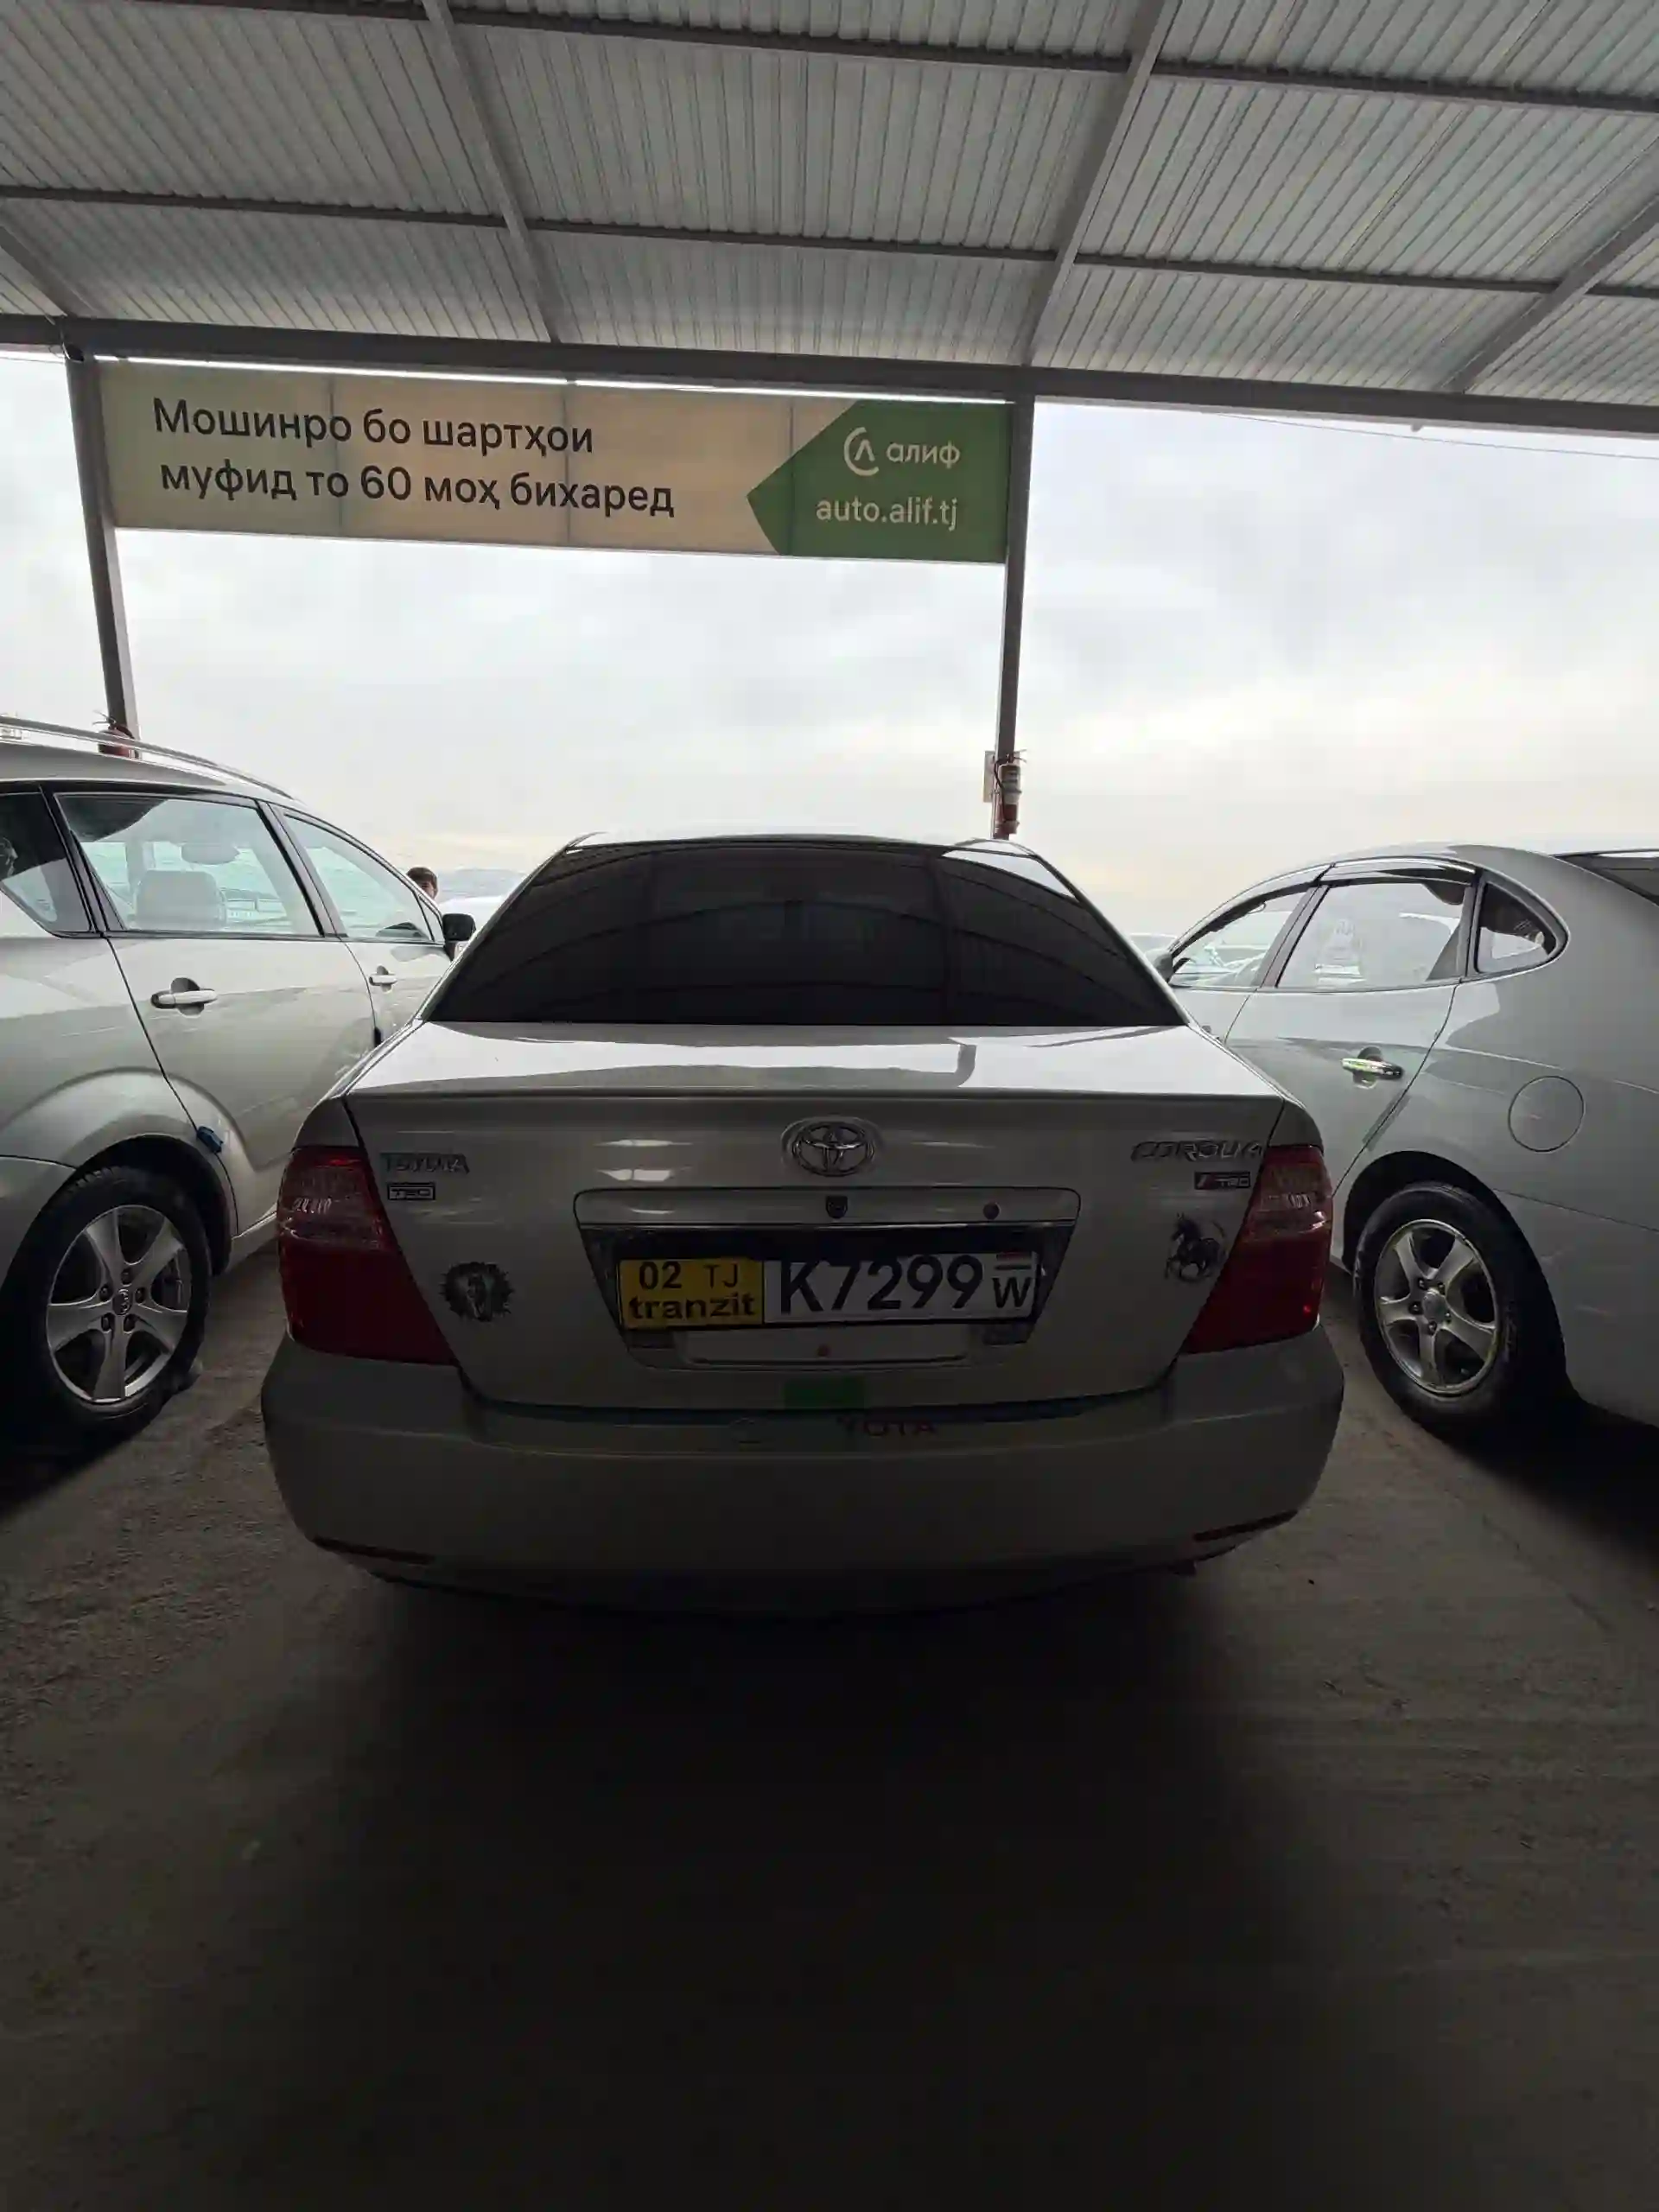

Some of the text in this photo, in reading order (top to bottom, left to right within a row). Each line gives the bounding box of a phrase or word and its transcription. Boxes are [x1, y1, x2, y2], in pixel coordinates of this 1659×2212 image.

[153, 397, 594, 456] Мошинро бо шартҳои
[886, 440, 961, 469] алиф
[161, 458, 675, 517] муфид то 60 моҳ бихаред
[815, 495, 958, 532] auto.alif.tj
[638, 1261, 739, 1290] 02 TJ
[779, 1255, 983, 1315] K7299
[993, 1276, 1029, 1309] W
[627, 1291, 756, 1320] tranzit
